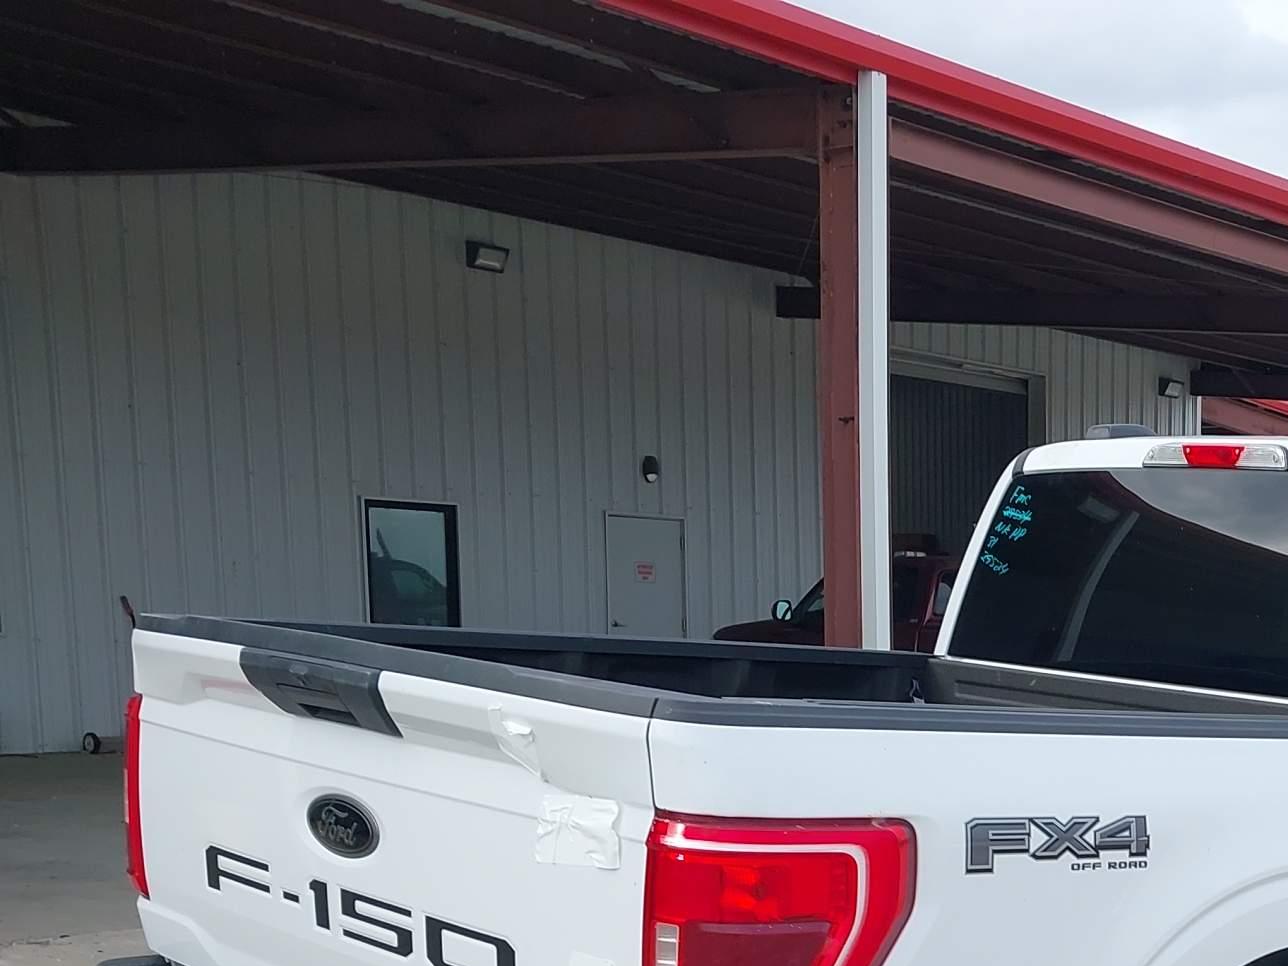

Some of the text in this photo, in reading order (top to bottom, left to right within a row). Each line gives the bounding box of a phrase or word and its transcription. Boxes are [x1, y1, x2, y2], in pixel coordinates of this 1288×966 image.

[317, 805, 359, 847] Ford
[965, 815, 1150, 875] FX4
[1070, 860, 1149, 871] OFF ROAD
